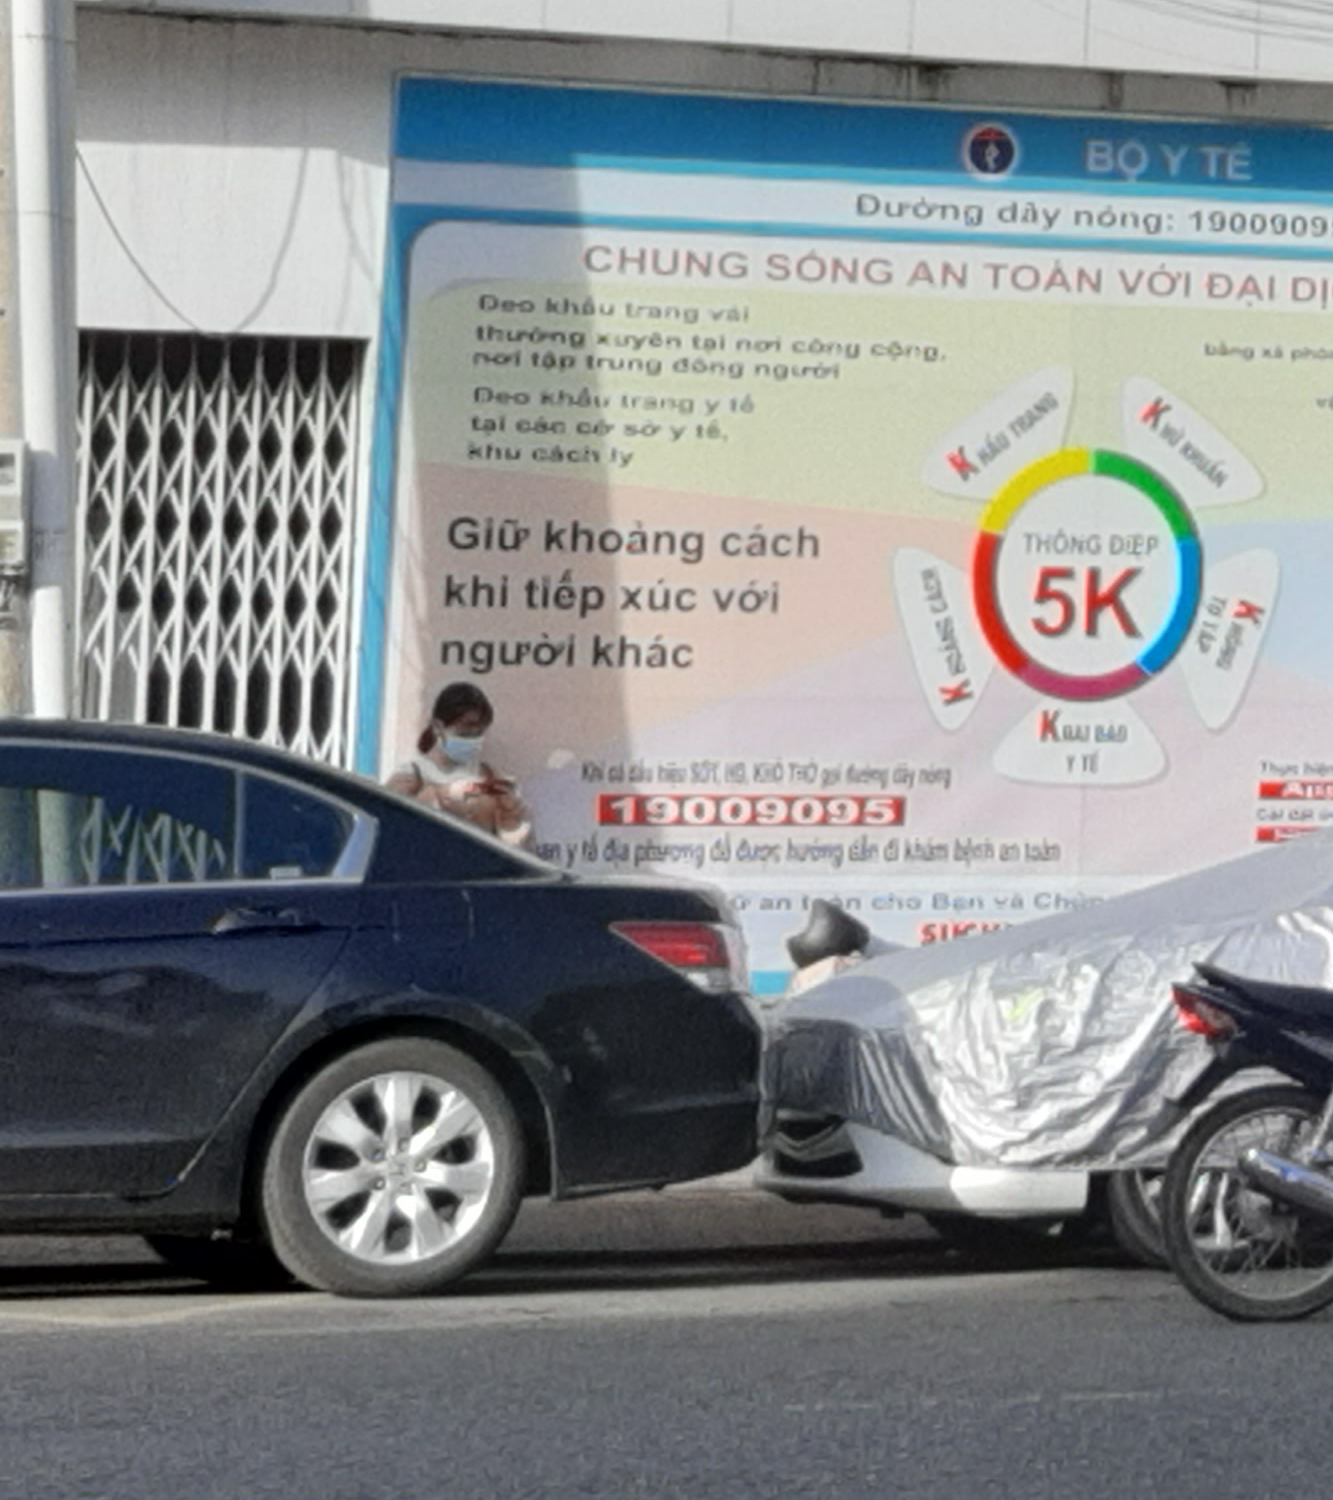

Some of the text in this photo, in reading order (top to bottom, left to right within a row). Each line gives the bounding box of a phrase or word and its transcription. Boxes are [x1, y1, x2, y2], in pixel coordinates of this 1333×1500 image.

[1086, 138, 1253, 183] BỘ Y TẾ
[581, 244, 749, 281] CHUNG
[765, 248, 893, 287] SỐNG
[907, 260, 970, 290] AN
[985, 259, 1102, 295] TOÀN
[1119, 263, 1191, 298] VỚI
[1205, 272, 1284, 316] ĐẠI
[447, 514, 820, 564] Giữ khoảng cách
[1024, 528, 1101, 556] THÔNG
[443, 569, 780, 618] khi tiếp xúc với
[1030, 565, 1143, 640] 5K
[440, 633, 693, 675] người khác
[610, 796, 897, 825] 19009095
